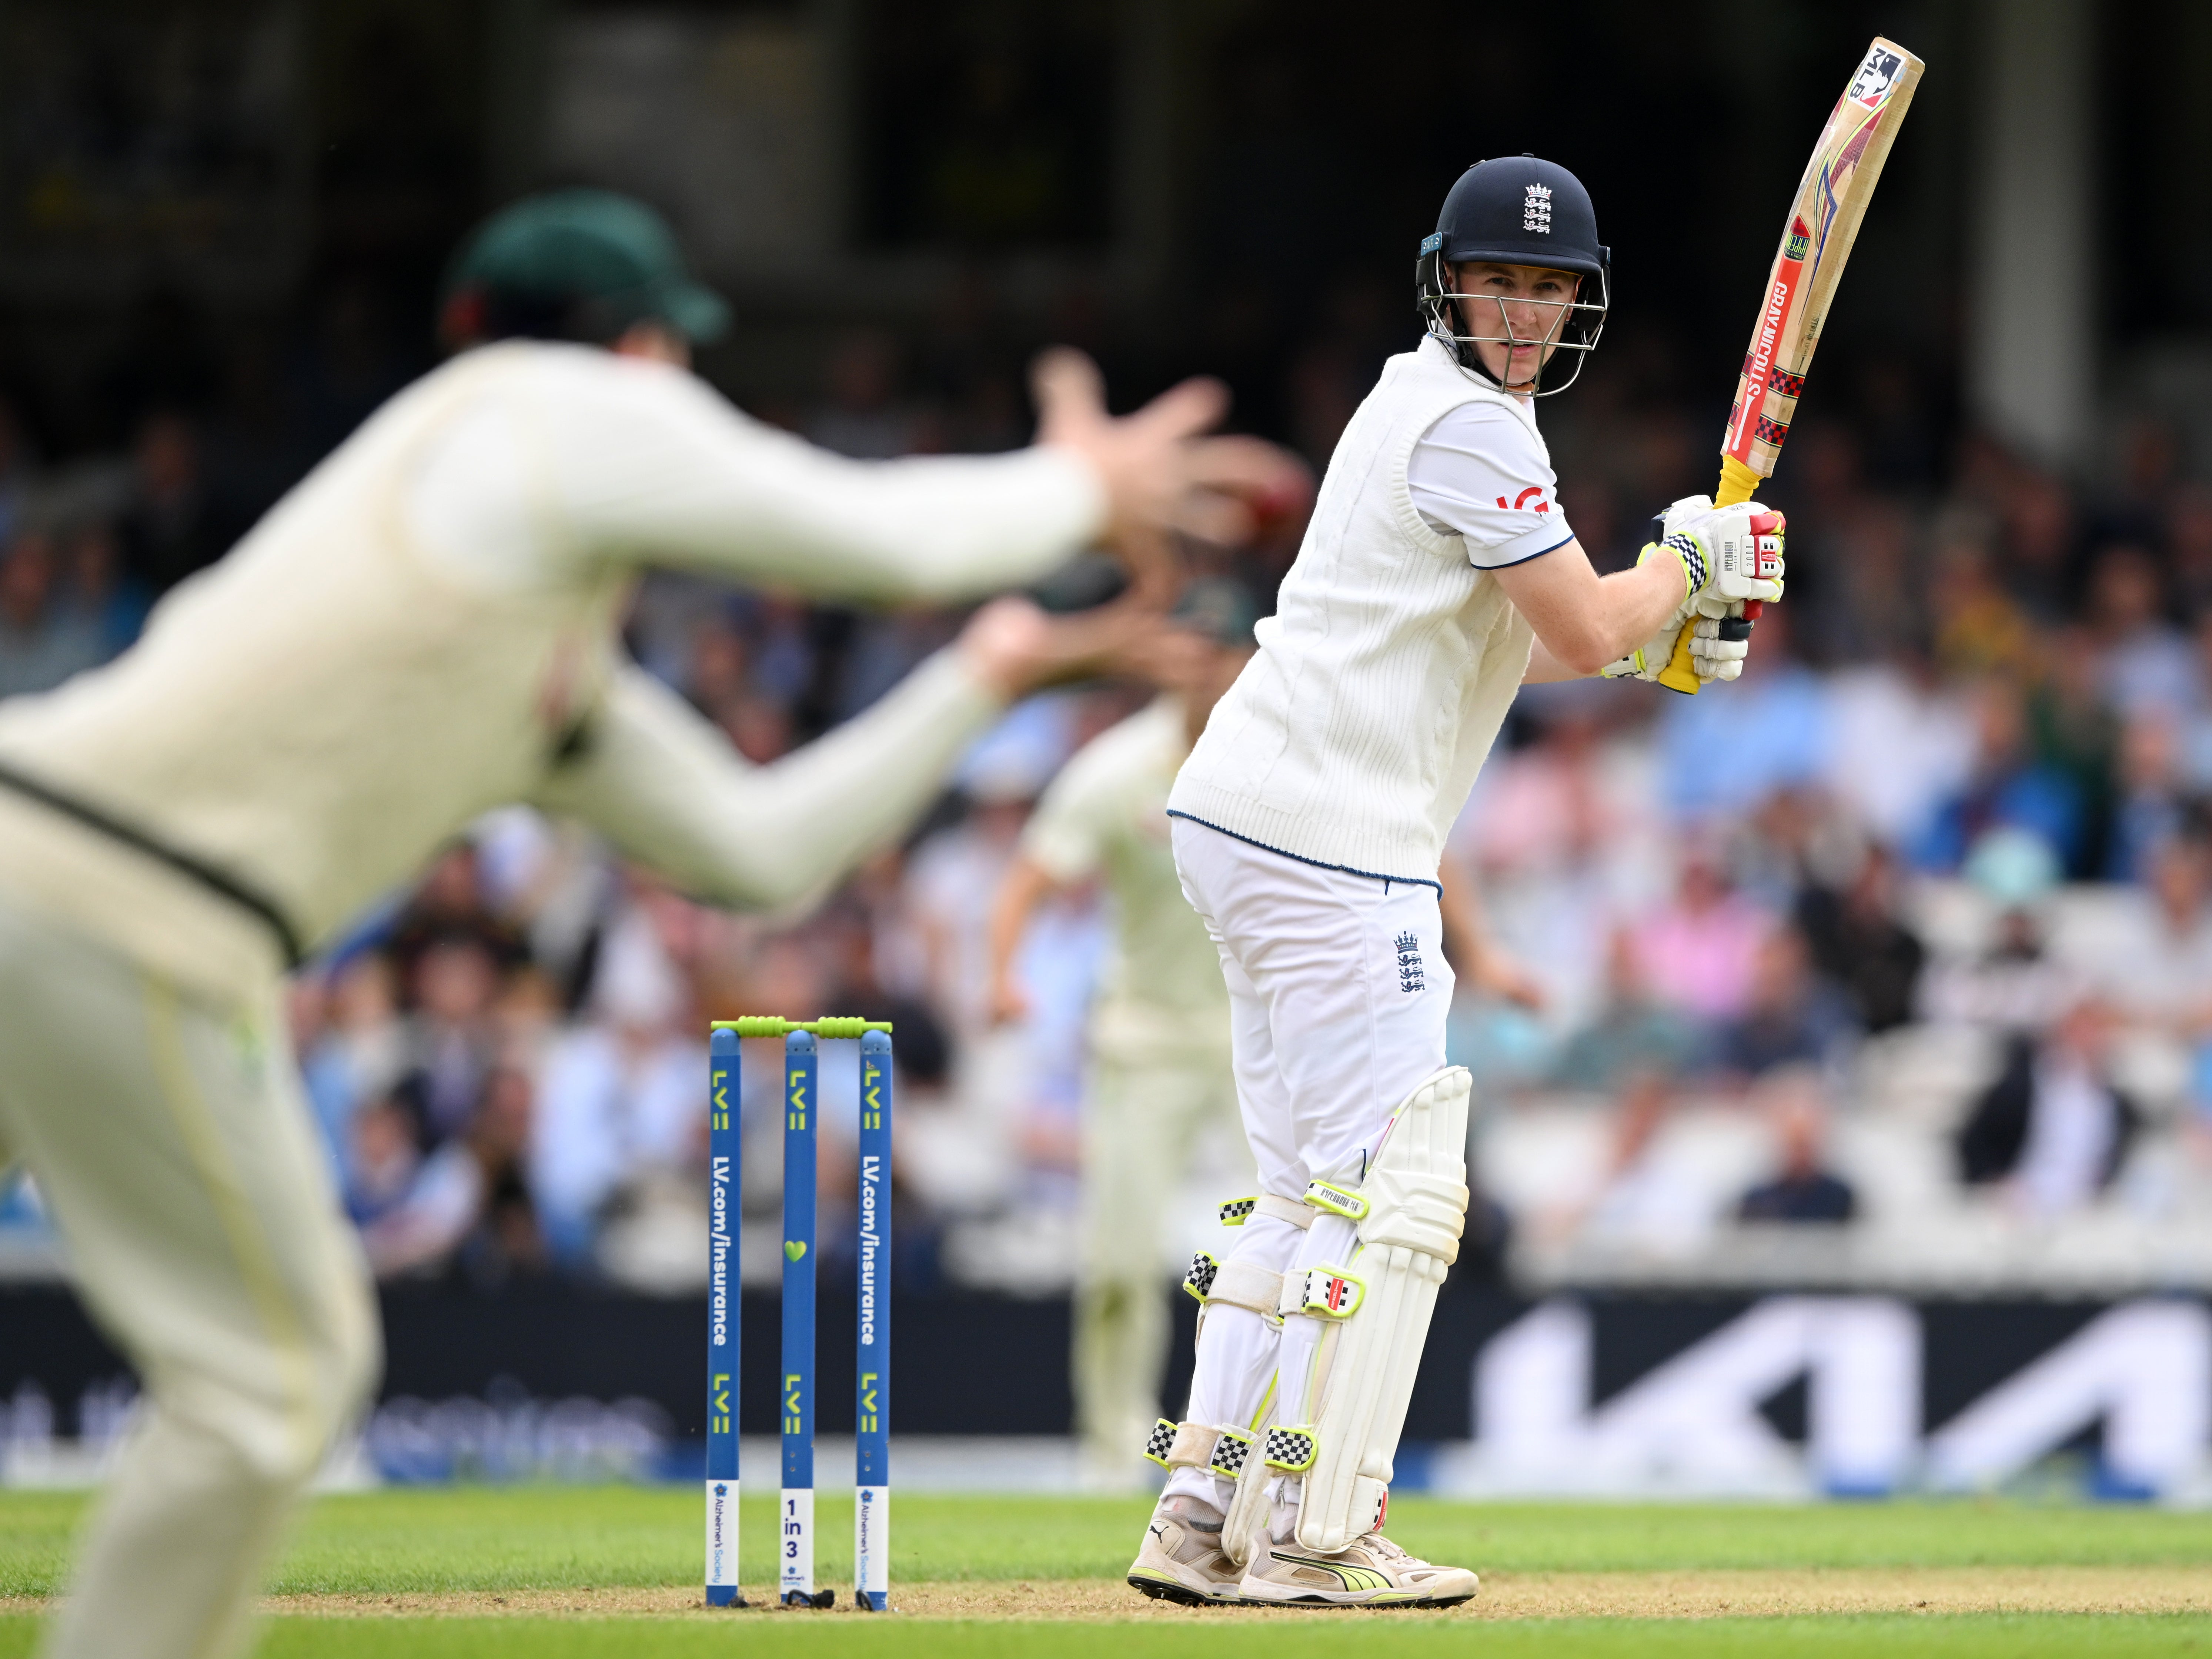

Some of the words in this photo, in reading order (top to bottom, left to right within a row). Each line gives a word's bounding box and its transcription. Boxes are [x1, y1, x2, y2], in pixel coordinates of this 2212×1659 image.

[1850, 47, 1887, 98] MLB
[1747, 281, 1787, 395] GRAY-NICOLLS
[711, 1157, 731, 1346] LV.com/insurance
[860, 1156, 880, 1345] LV.com/insurance
[715, 1499, 724, 1548] Alzheimer's
[785, 1518, 801, 1535] in
[788, 1499, 795, 1516] 1
[861, 1505, 869, 1553] Alzheimer's
[712, 1549, 724, 1583] Society
[786, 1541, 798, 1558] 3
[859, 1555, 869, 1589] Society
